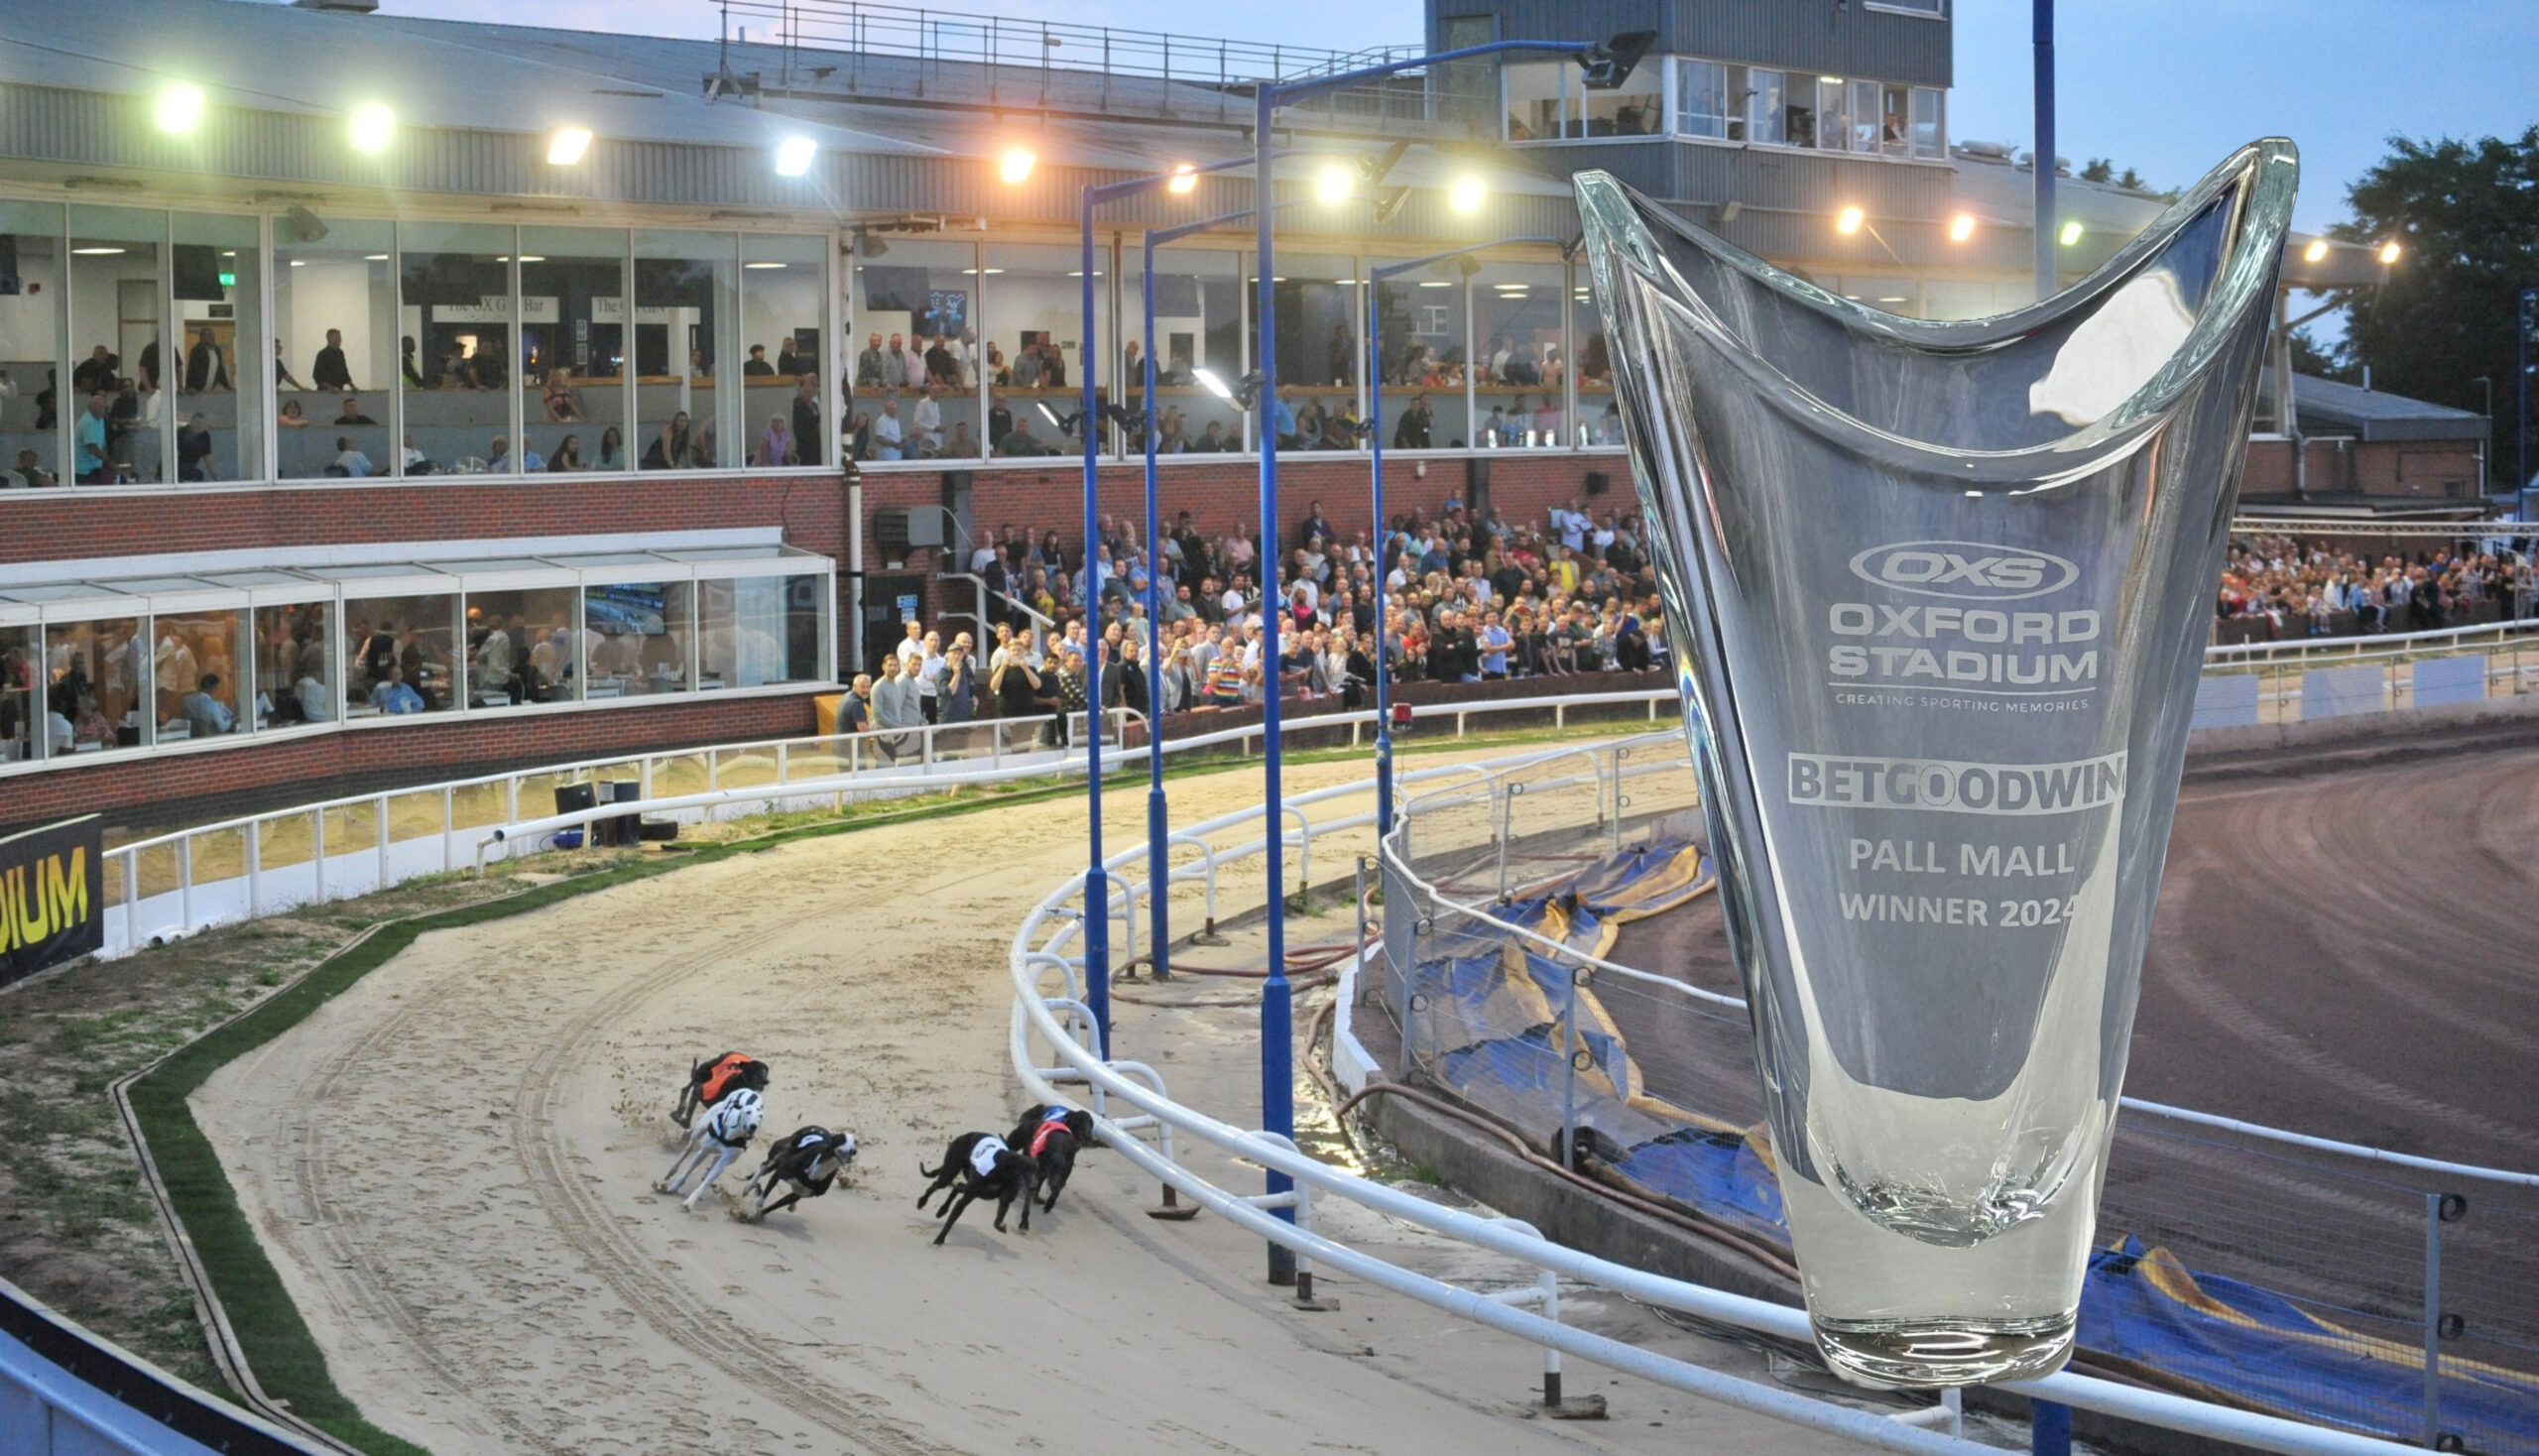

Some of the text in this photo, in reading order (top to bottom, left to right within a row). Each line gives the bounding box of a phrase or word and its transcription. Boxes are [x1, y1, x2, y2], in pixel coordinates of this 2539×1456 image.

[524, 299, 544, 311] Bar
[597, 299, 618, 312] The
[1881, 551, 2046, 588] OXS
[1829, 602, 2101, 645] OXFORD
[1829, 645, 2098, 684] STADIUM
[1835, 693, 2090, 714] CREATING SPORTING MEMORIES
[1790, 756, 2126, 811] BETGOODWIN
[1850, 838, 2075, 877] PALL MALL
[1839, 893, 1989, 926] WINNER
